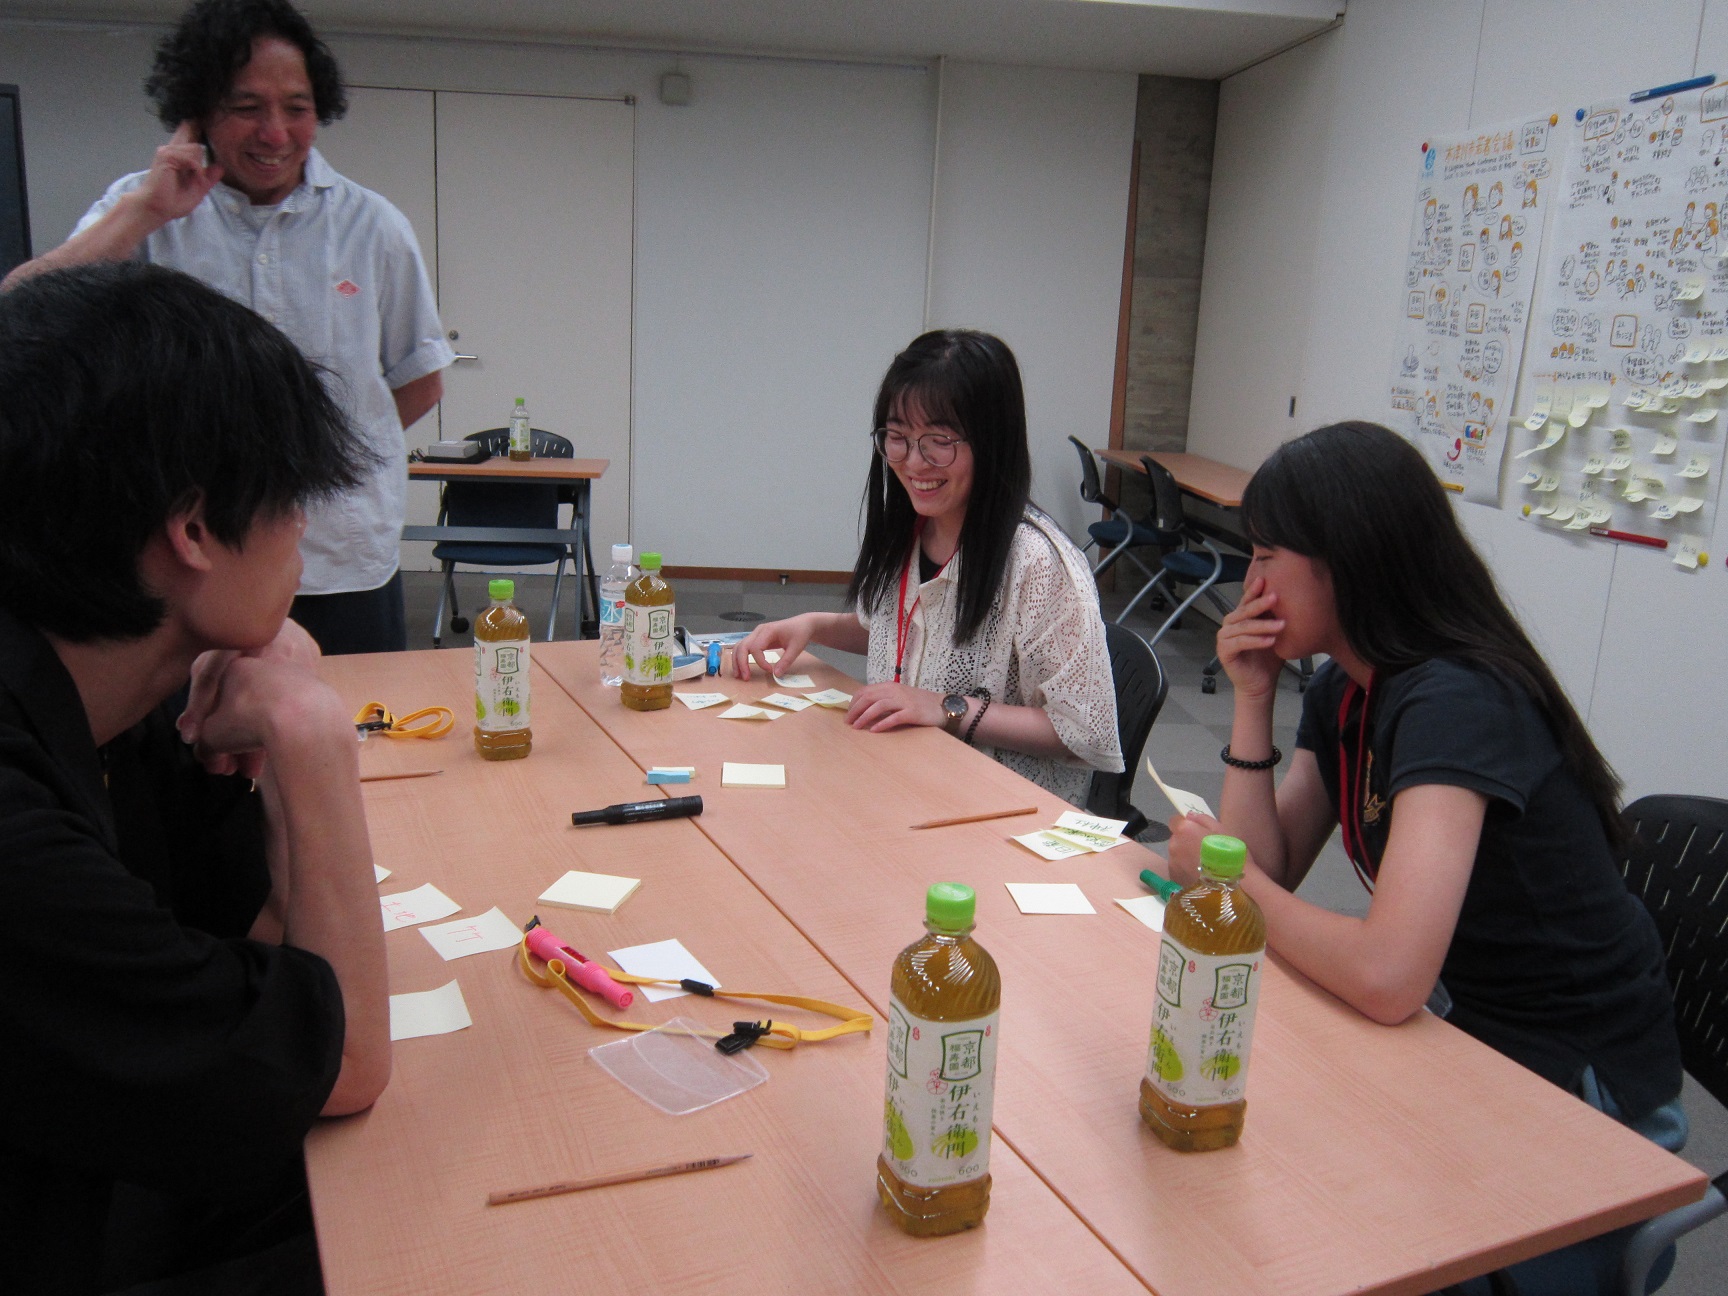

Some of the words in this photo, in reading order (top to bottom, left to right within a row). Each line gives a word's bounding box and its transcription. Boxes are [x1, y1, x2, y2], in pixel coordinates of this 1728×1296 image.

[603, 600, 621, 623] 水
[1229, 972, 1245, 1000] 京都
[961, 1040, 977, 1070] 京都
[1211, 1012, 1238, 1082] 伊右衛門
[1221, 1088, 1240, 1098] 600
[946, 1084, 972, 1160] 伊右衛門
[958, 1164, 980, 1176] 600
